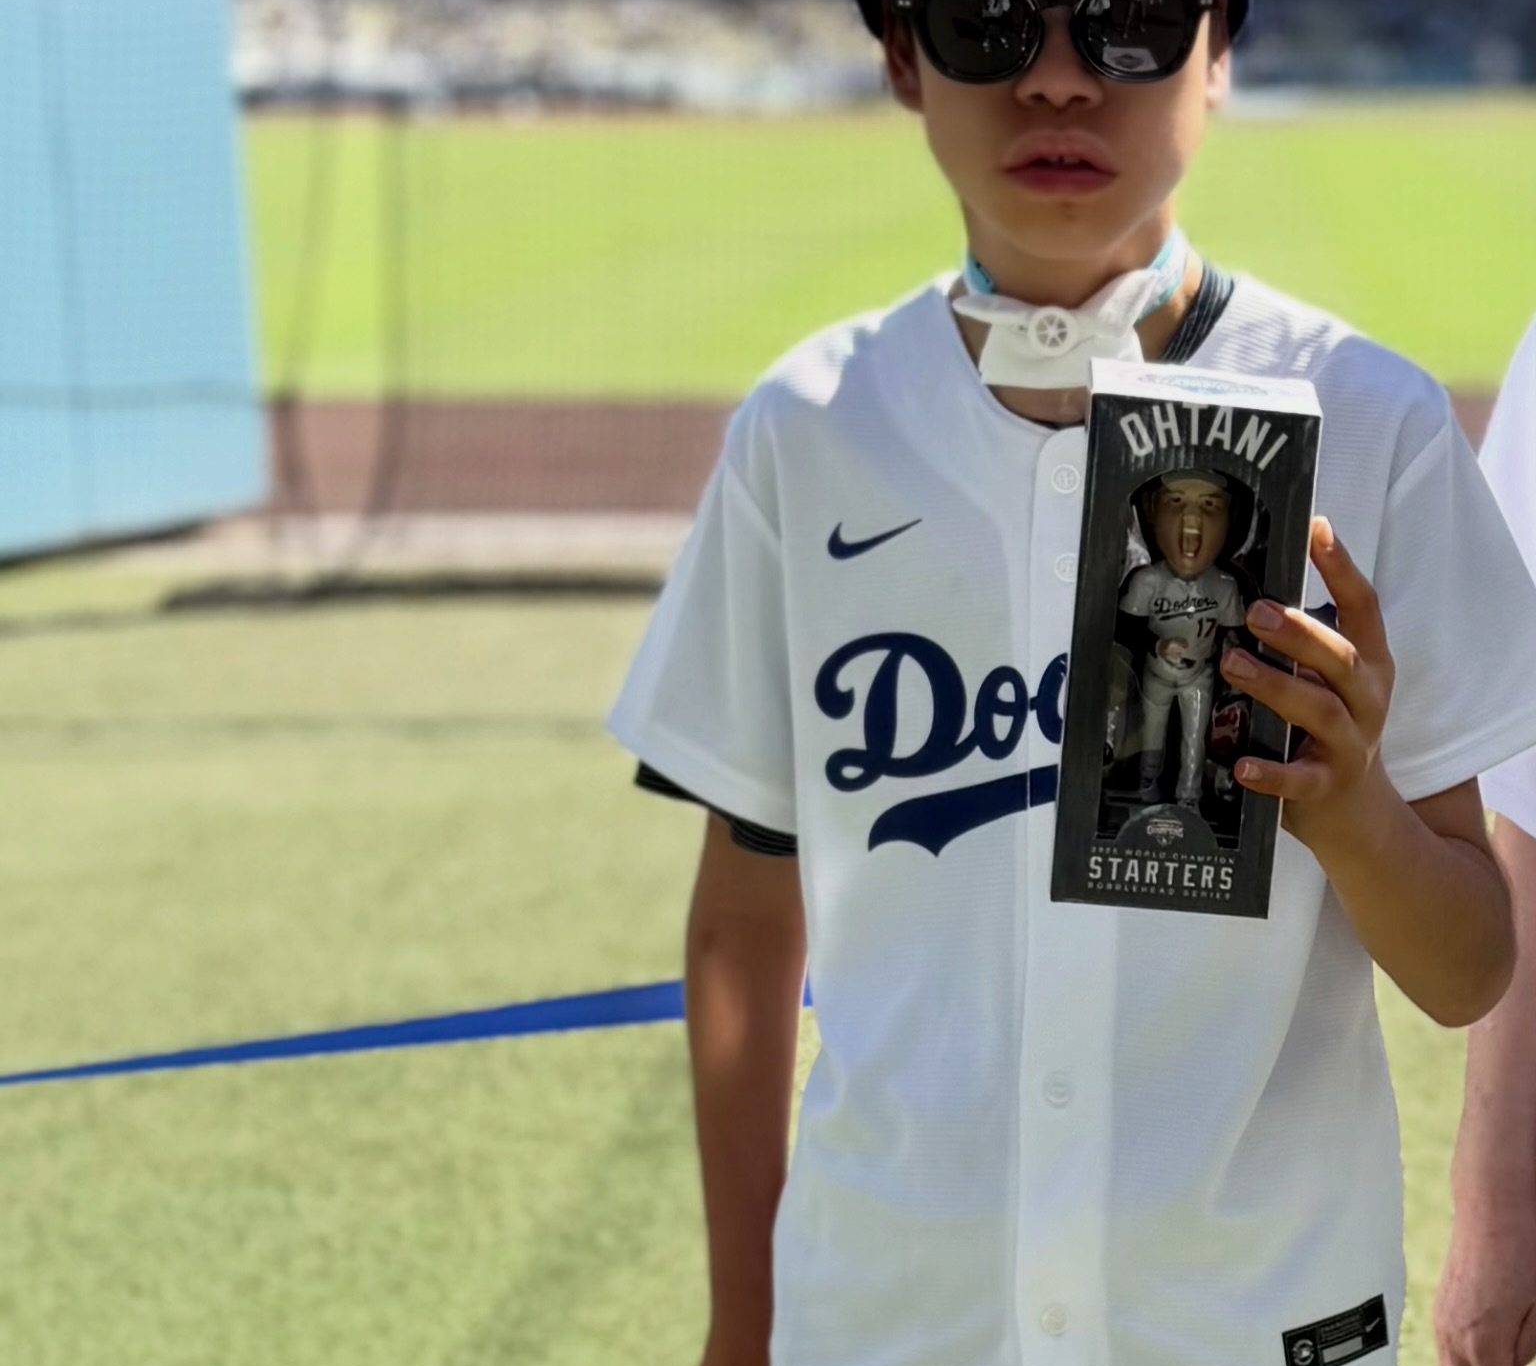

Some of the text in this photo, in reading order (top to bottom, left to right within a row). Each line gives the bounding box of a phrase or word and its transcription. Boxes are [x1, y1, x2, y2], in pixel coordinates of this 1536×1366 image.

[1119, 400, 1289, 472] OHTANI
[1197, 617, 1217, 639] 17
[1088, 855, 1234, 891] STARTERS
[1173, 853, 1235, 865] CHAMPION
